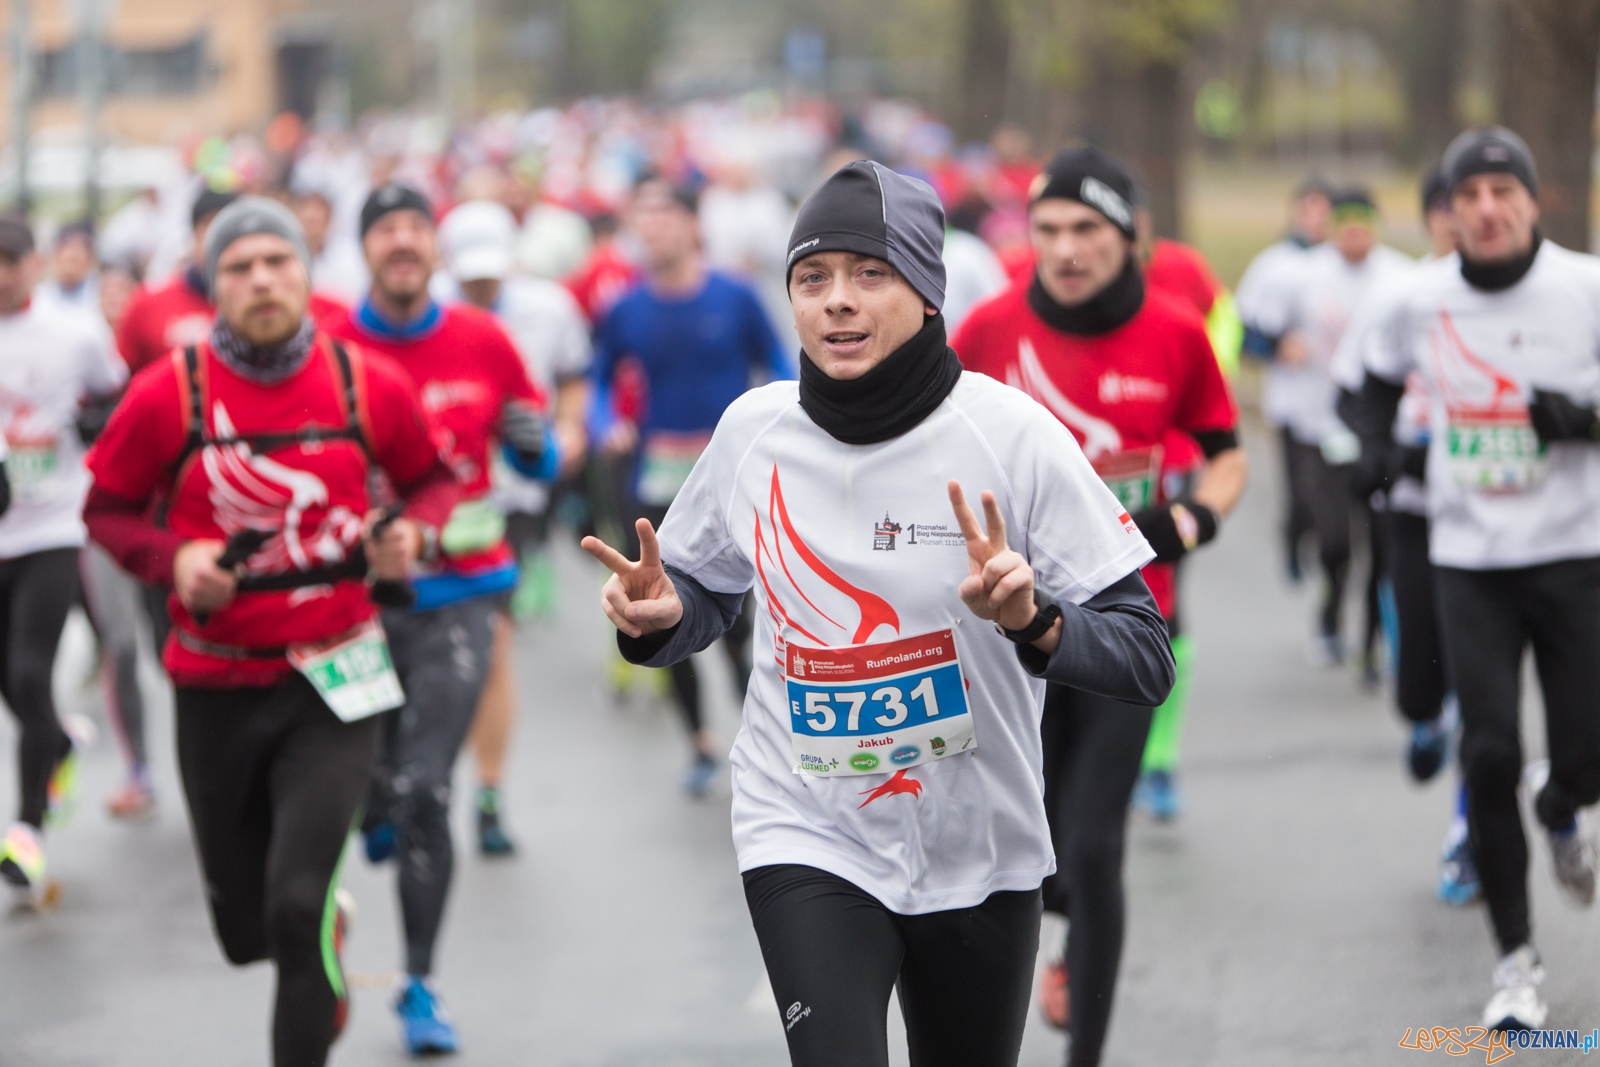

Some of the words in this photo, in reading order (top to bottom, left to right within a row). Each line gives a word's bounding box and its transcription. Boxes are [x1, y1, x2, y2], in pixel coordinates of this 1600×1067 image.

[907, 523, 917, 544] 1
[866, 646, 943, 669] RunPoland.org
[808, 660, 817, 674] 1
[791, 700, 801, 716] E
[805, 676, 940, 732] 5731
[857, 737, 894, 748] Jakub
[801, 754, 824, 764] GRUPA
[801, 762, 830, 772] LUXMED
